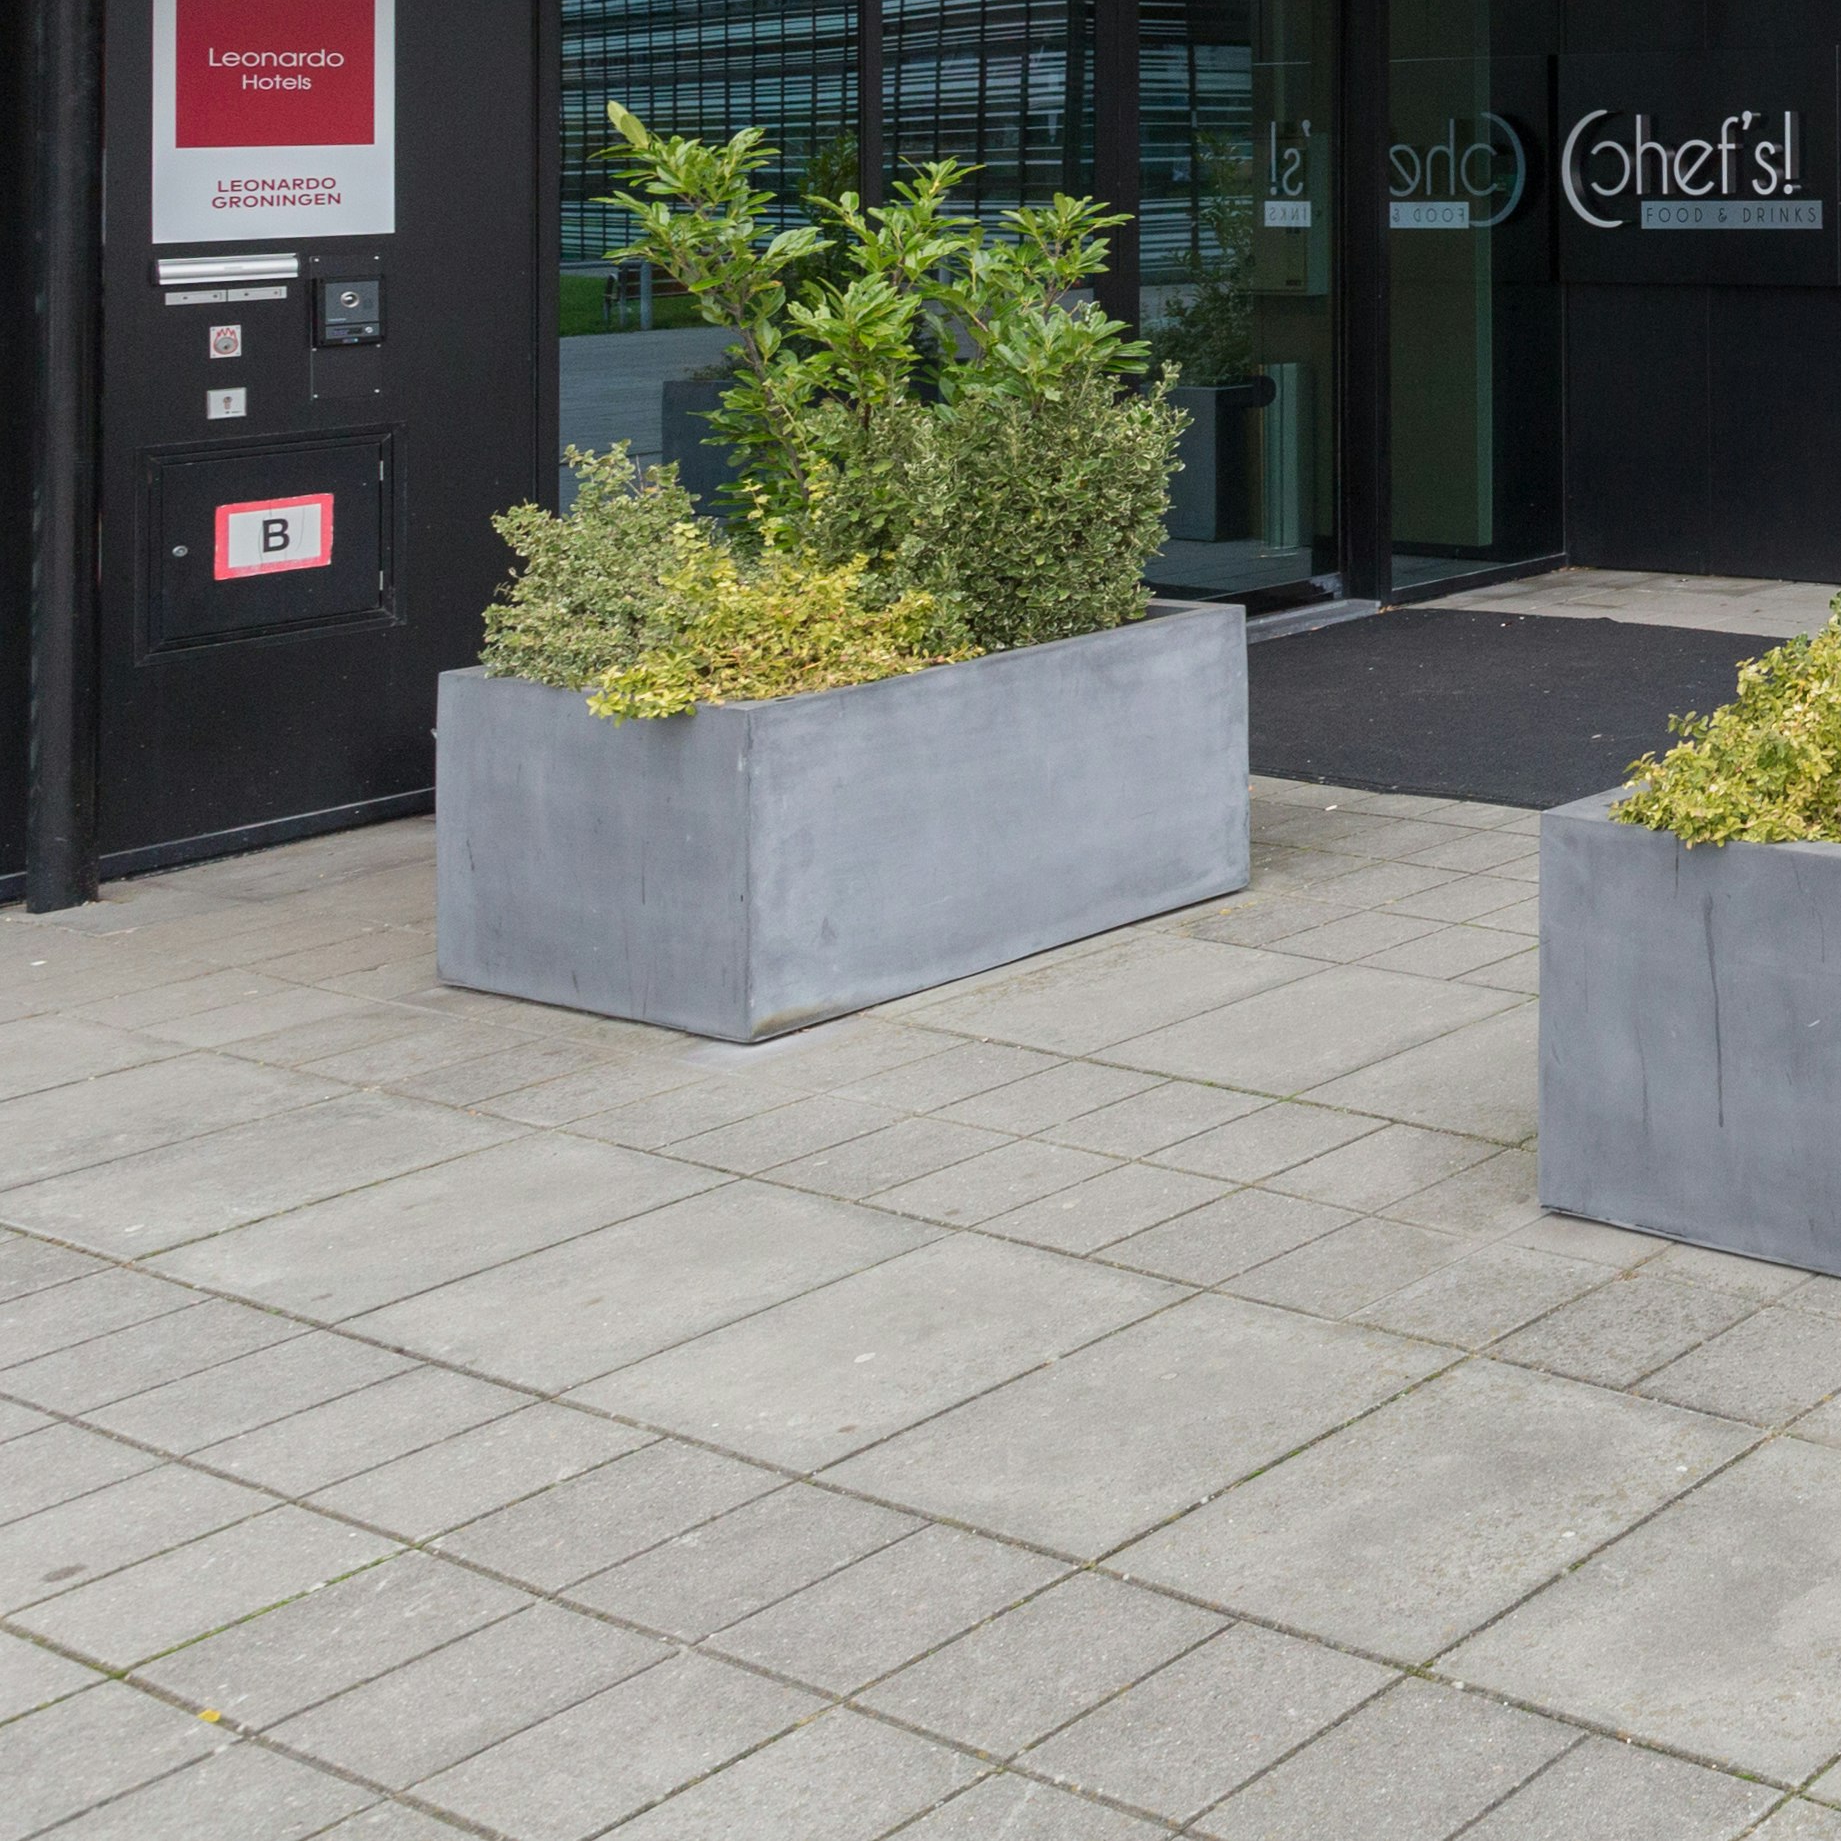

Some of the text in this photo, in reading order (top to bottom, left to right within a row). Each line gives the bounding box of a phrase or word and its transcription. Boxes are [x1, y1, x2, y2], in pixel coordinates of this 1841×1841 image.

[208, 47, 345, 68] Leonardo
[242, 74, 312, 90] Hotels
[1561, 109, 1800, 229] Chef's!
[217, 177, 337, 193] LEONARDO
[211, 192, 342, 209] GRONINGEN
[1645, 206, 1818, 224] FOOD & DRINKS
[262, 518, 291, 554] B
